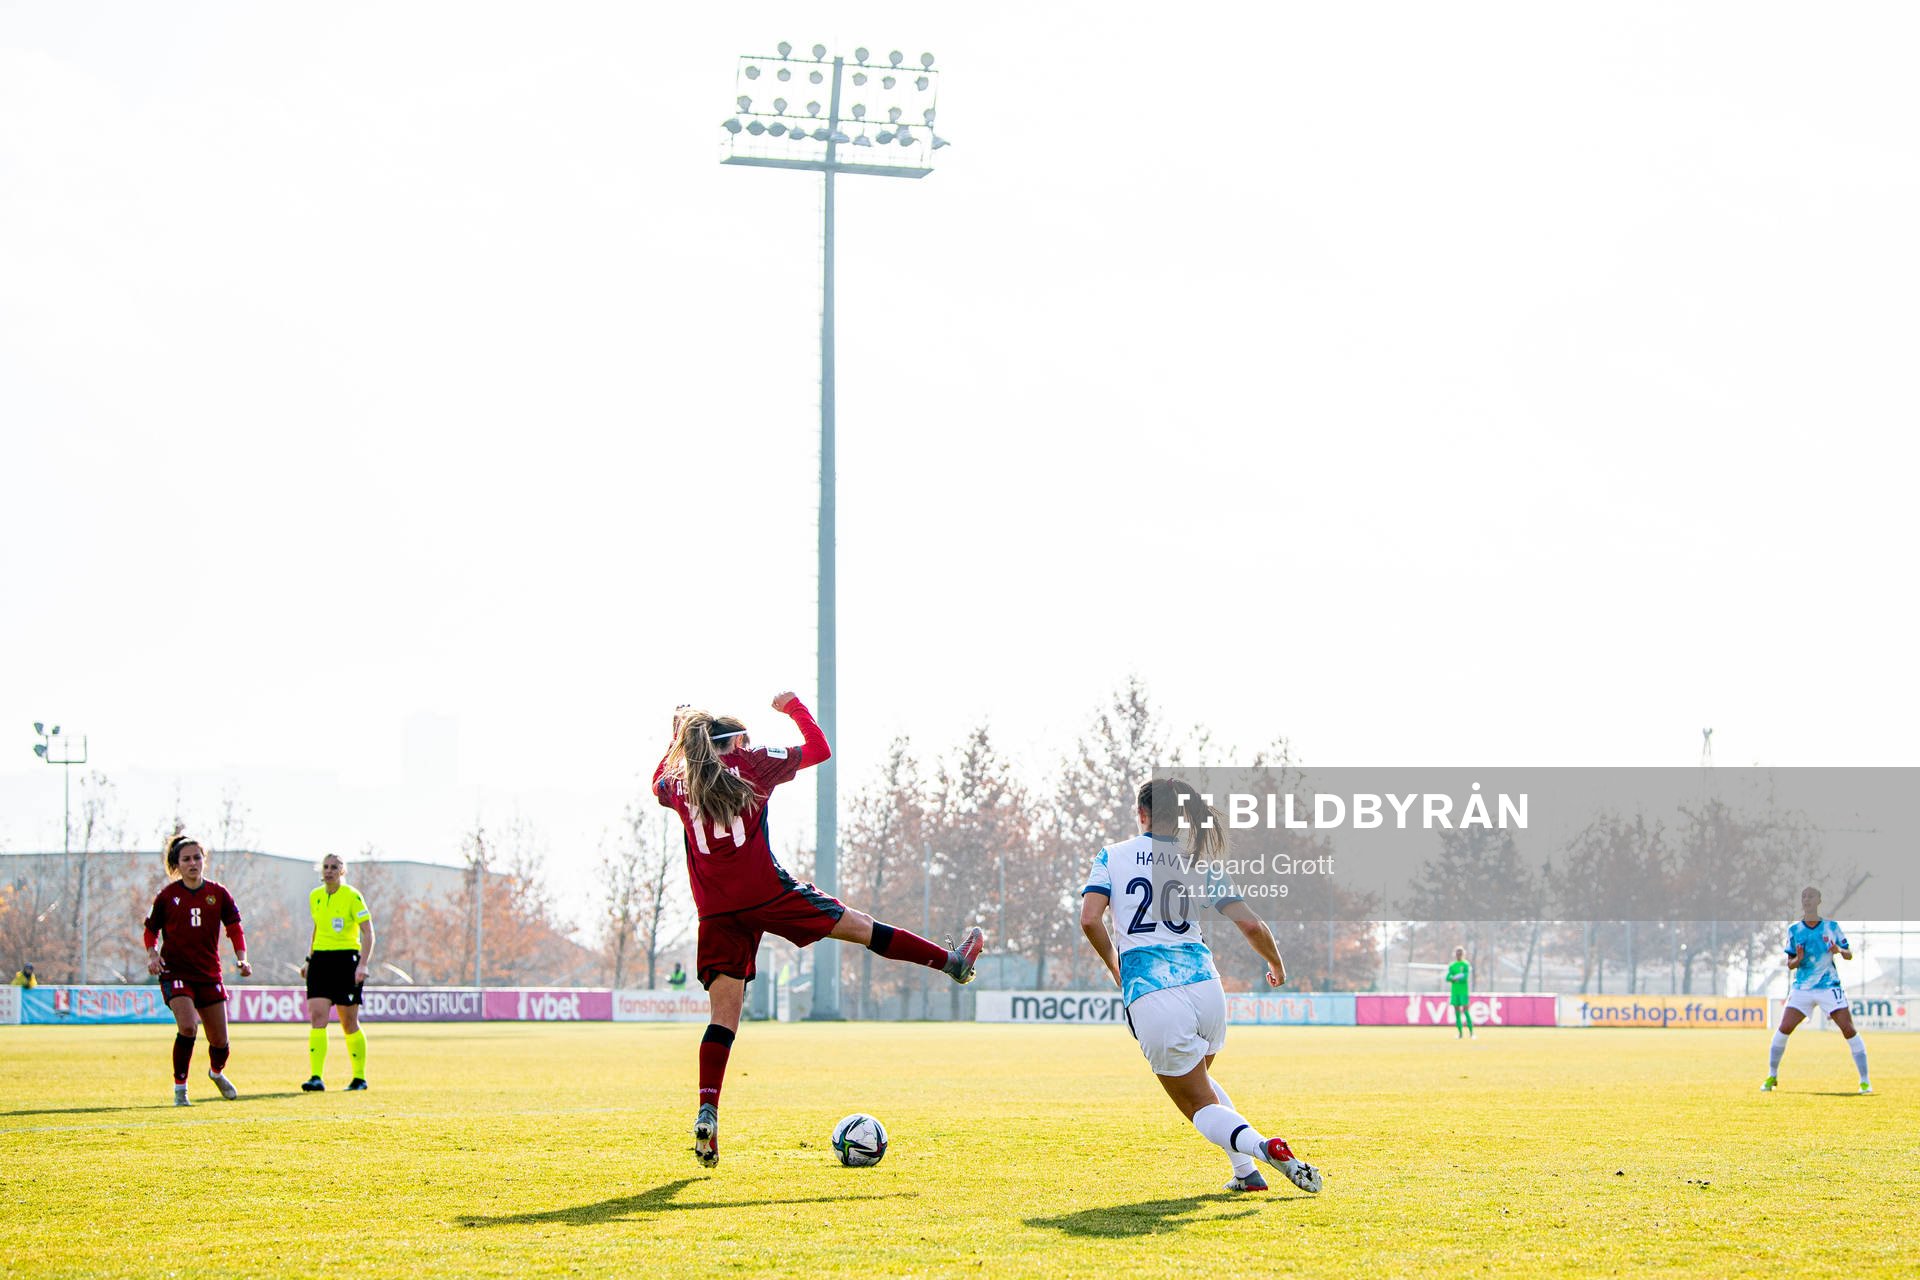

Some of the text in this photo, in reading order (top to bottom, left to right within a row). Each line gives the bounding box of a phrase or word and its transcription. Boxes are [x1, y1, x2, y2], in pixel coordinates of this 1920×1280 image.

[190, 907, 202, 927] 8
[1125, 876, 1190, 935] 20
[246, 991, 304, 1020] vbet
[359, 992, 479, 1016] EDCONSTRUCT
[530, 992, 580, 1021] vbet
[619, 995, 709, 1018] fanshop.ffa.a
[1011, 996, 1126, 1021] macron
[1580, 1002, 1764, 1027] fanshop.ffa.am
